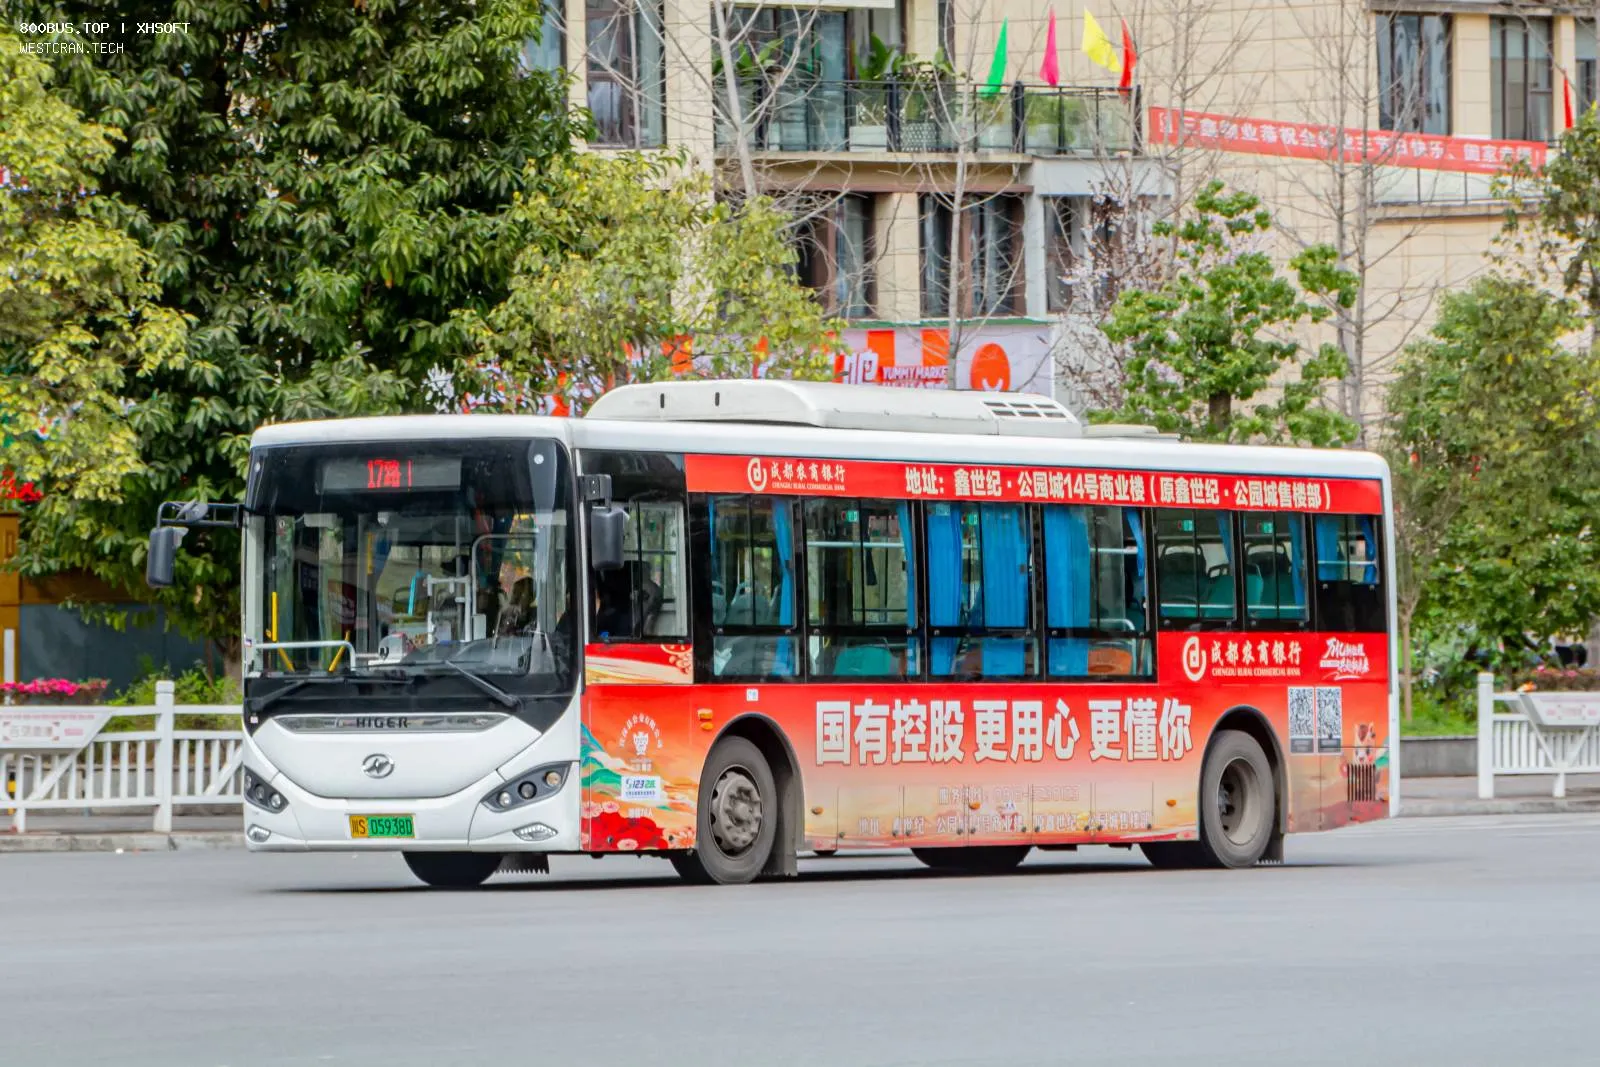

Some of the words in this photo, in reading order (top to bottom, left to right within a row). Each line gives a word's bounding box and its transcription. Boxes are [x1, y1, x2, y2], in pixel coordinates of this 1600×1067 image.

[771, 461, 846, 483] 成都农商银行
[1211, 639, 1302, 666] 成都农商银行
[356, 716, 408, 729] HIGER
[815, 698, 965, 766] 国有控股
[972, 698, 1080, 763] 更用心
[1088, 697, 1193, 762] 更懂你
